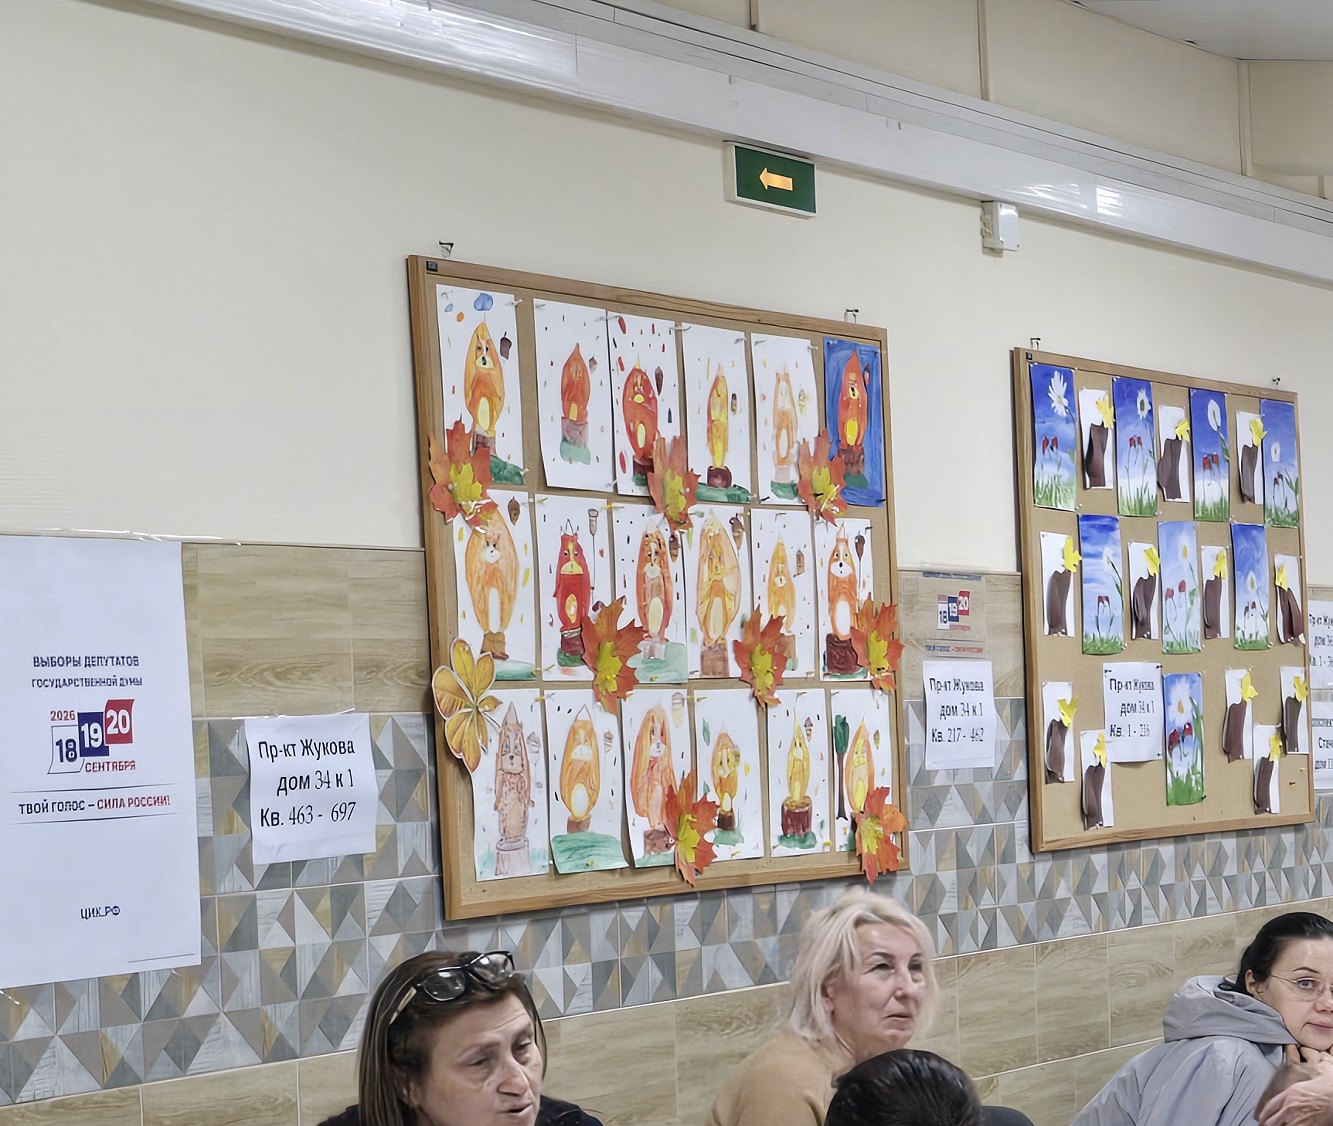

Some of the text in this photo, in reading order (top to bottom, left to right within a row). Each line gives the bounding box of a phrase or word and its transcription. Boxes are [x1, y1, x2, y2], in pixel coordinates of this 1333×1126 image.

[33, 656, 140, 668] ВЫБОРЫ ДЕПУТАТОВ
[32, 675, 117, 688] ГОСУДАРСТВЕННОЙ
[50, 710, 75, 721] 2026
[940, 705, 958, 720] дом
[55, 709, 130, 763] 18 19 20
[948, 728, 961, 743] 217
[258, 738, 355, 763] Пр-кт Жукова
[85, 760, 136, 772] СЕНТЯБРЯ
[277, 769, 354, 796] дом 34 к 1
[19, 799, 49, 815] ТВОЙ
[52, 800, 85, 812] ГОЛОС
[97, 798, 125, 810] СИЛА
[128, 795, 171, 808] РОССИИ!
[260, 808, 284, 827] Кв.
[289, 805, 313, 825] 463
[331, 802, 356, 822] 697
